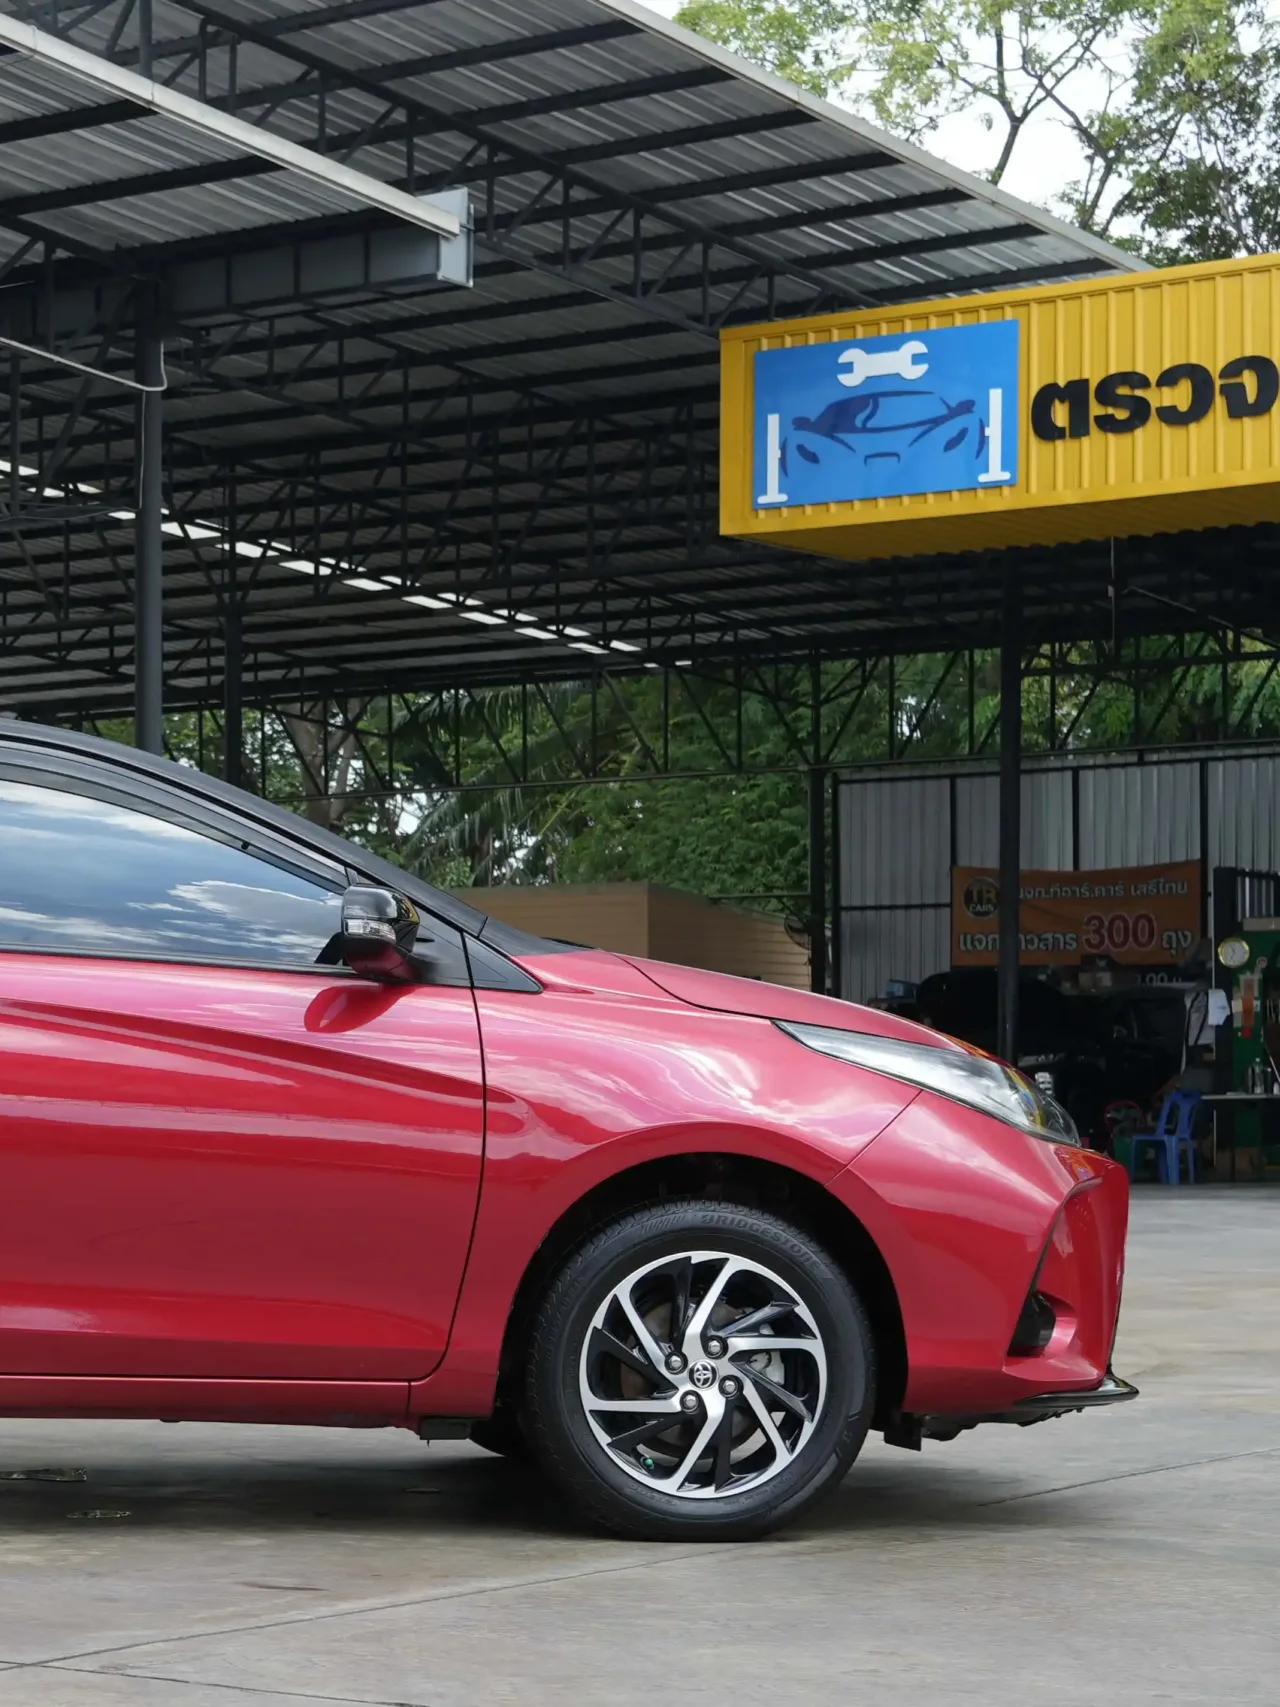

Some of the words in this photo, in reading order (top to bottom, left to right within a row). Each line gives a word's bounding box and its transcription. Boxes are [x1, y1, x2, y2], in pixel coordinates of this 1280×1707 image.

[1031, 355, 1280, 441] ตรวจ
[969, 884, 997, 902] TR
[1082, 912, 1157, 953] 300
[1162, 930, 1193, 956] ถุง
